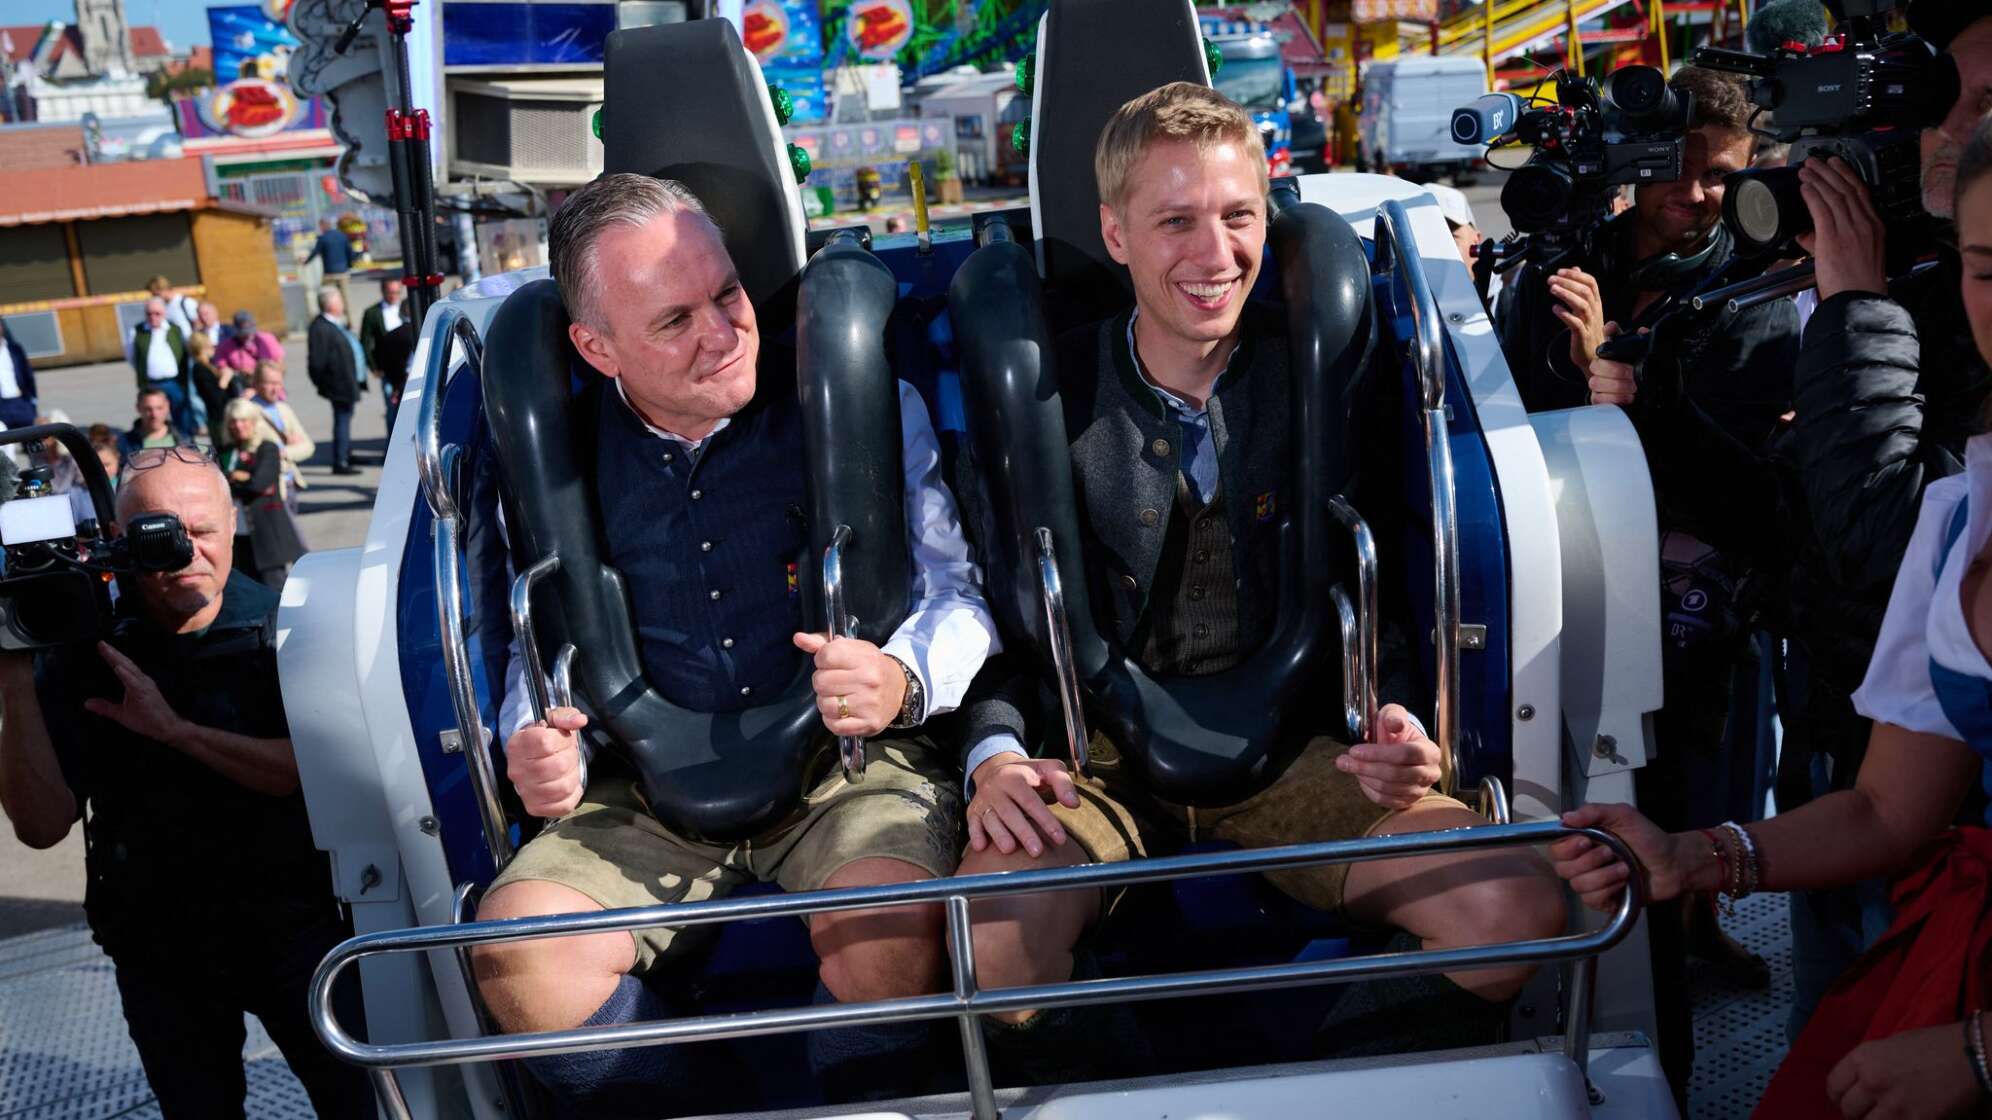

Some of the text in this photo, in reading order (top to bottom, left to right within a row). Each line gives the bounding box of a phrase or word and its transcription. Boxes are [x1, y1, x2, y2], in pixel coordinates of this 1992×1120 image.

[1817, 84, 1841, 93] SONY
[1647, 145, 1671, 153] SONY
[142, 522, 165, 530] Canon
